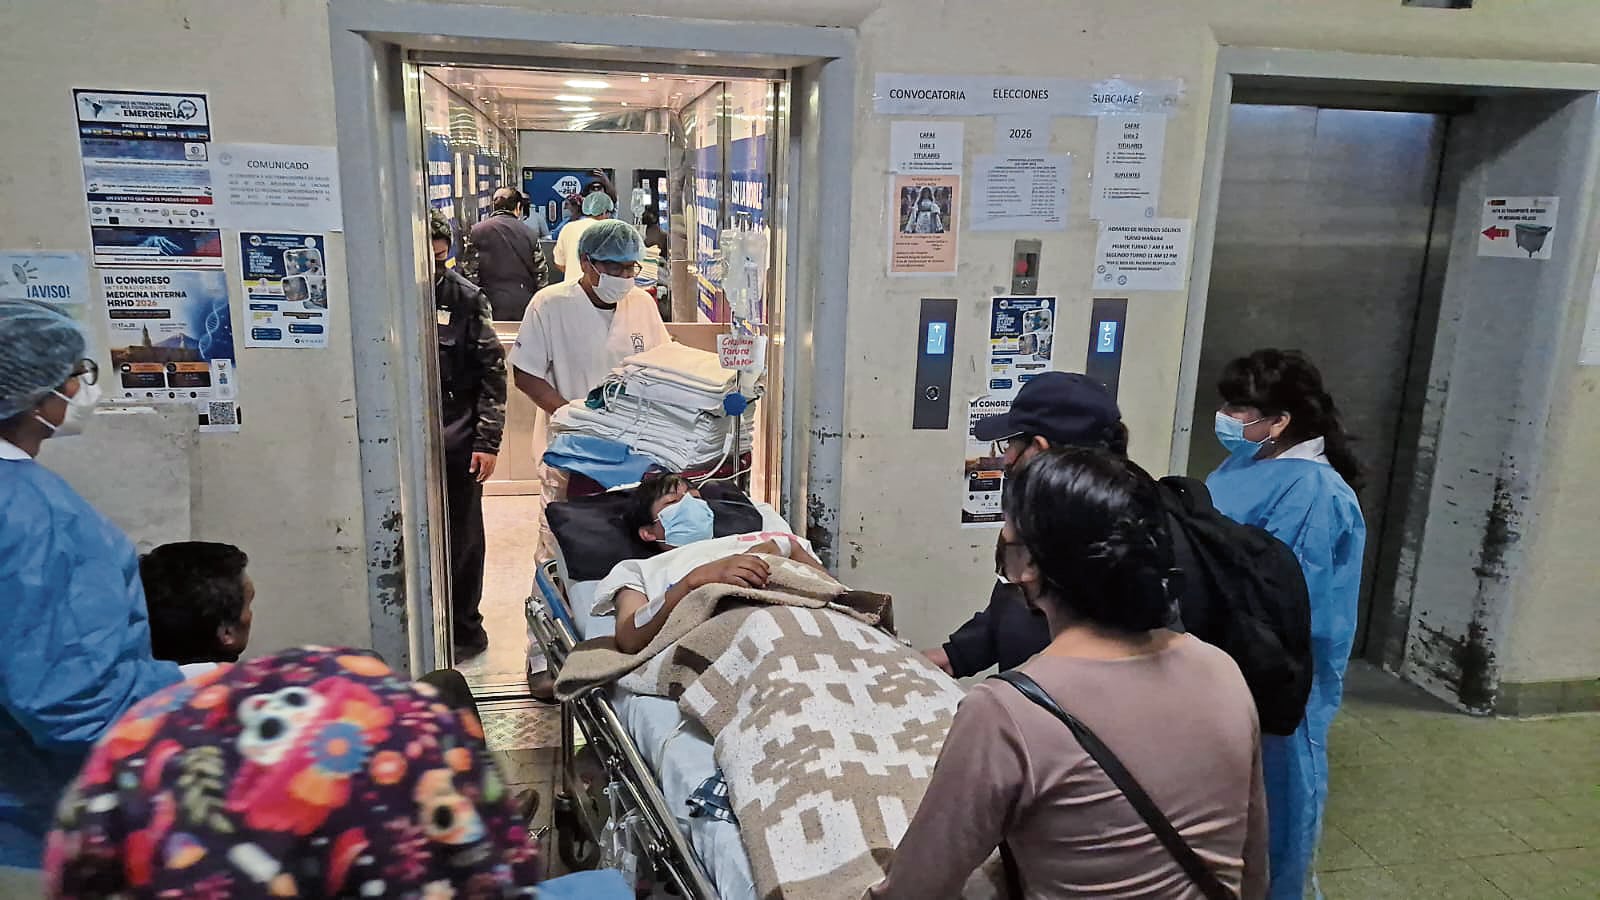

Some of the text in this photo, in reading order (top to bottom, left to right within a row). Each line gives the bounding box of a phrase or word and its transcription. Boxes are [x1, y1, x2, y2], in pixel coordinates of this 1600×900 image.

[889, 88, 1140, 105] CONVOCATORIA ELECCIONES SUBCAFAE
[1009, 128, 1033, 139] 2026
[246, 159, 310, 171] COMUNICADO
[103, 275, 170, 285] III CONGRESO
[26, 284, 71, 299] ¡AVISO!
[106, 291, 187, 299] MEDICINA INTERNA
[107, 299, 158, 307] HRHD 2026
[1103, 332, 1112, 346] 5
